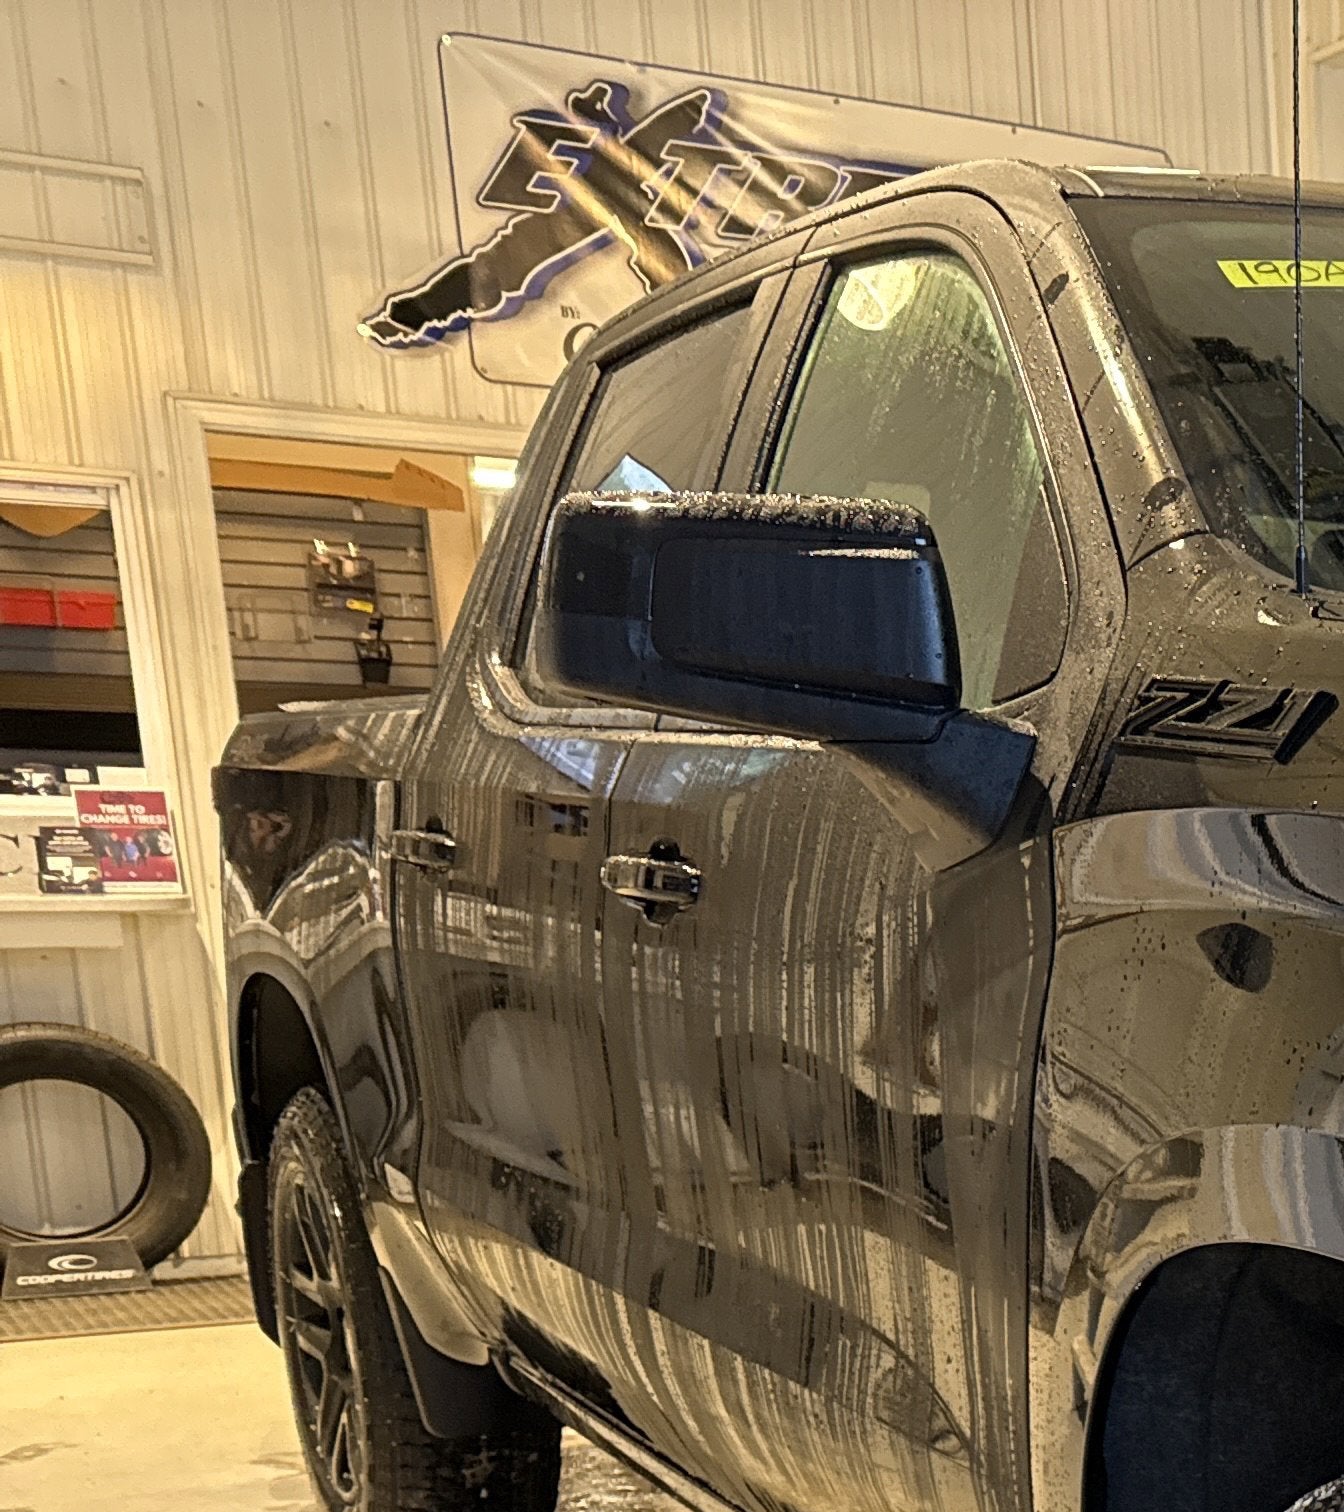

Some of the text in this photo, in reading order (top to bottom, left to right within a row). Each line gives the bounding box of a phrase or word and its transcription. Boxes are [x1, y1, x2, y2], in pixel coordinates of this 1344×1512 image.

[98, 804, 146, 814] TIME TO
[80, 813, 130, 825] CHANGE
